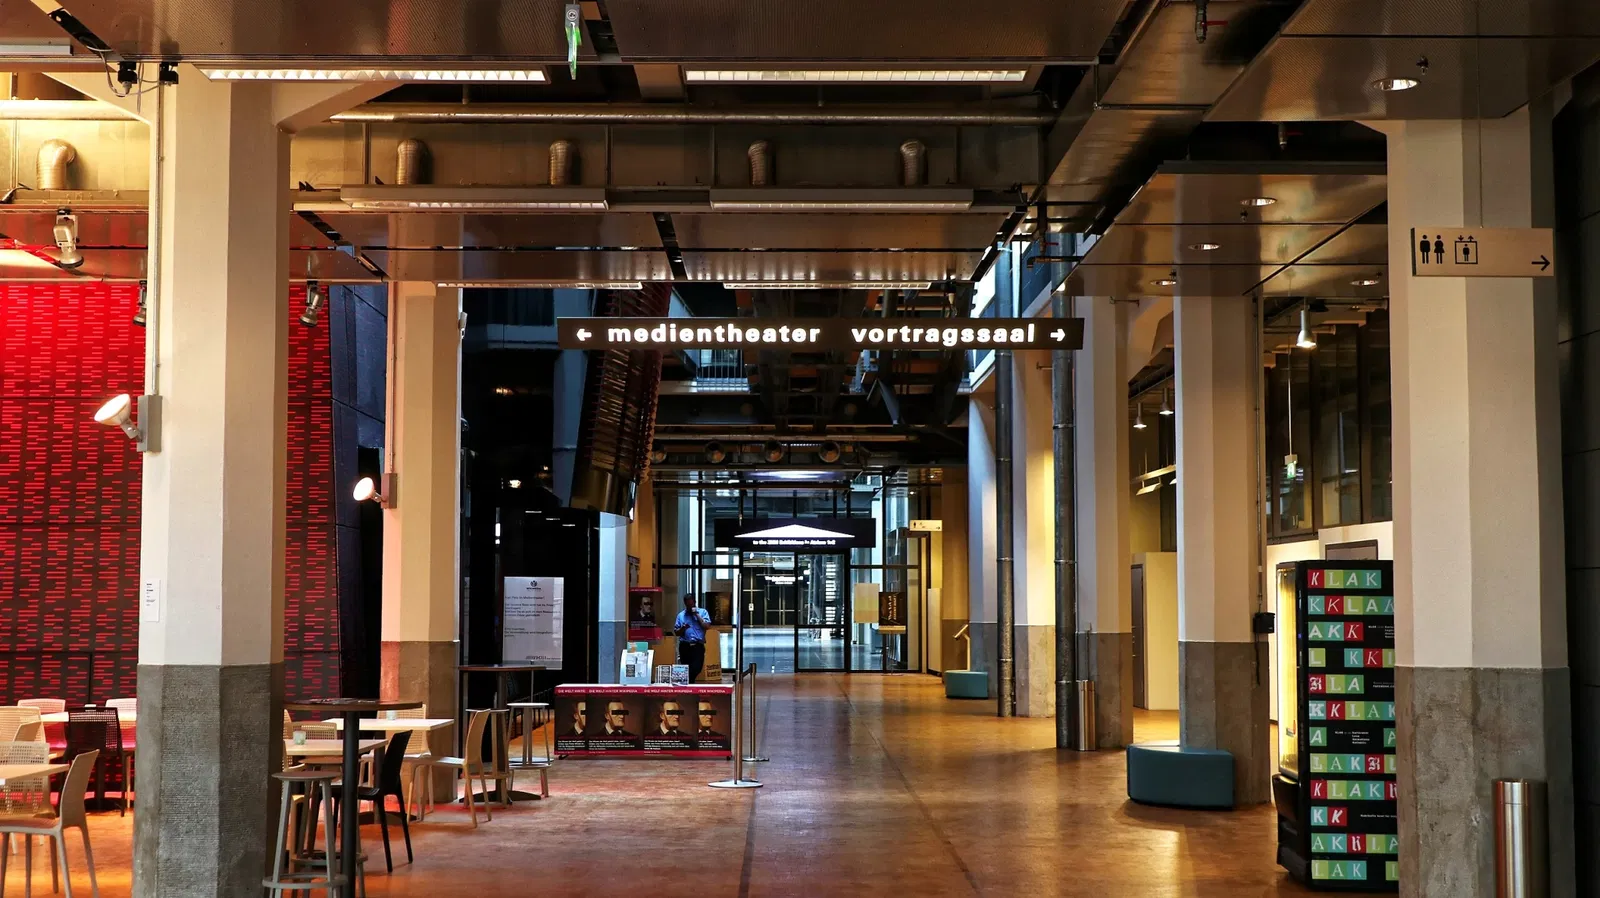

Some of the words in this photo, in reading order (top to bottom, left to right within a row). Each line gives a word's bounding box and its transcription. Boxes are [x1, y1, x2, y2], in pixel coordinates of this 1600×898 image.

[607, 323, 821, 343] medientheater
[851, 323, 1036, 347] vortragssaal
[1311, 572, 1378, 586] KLAK
[1308, 624, 1360, 639] AKK
[1313, 808, 1343, 824] KK
[1314, 862, 1362, 877] LAK
